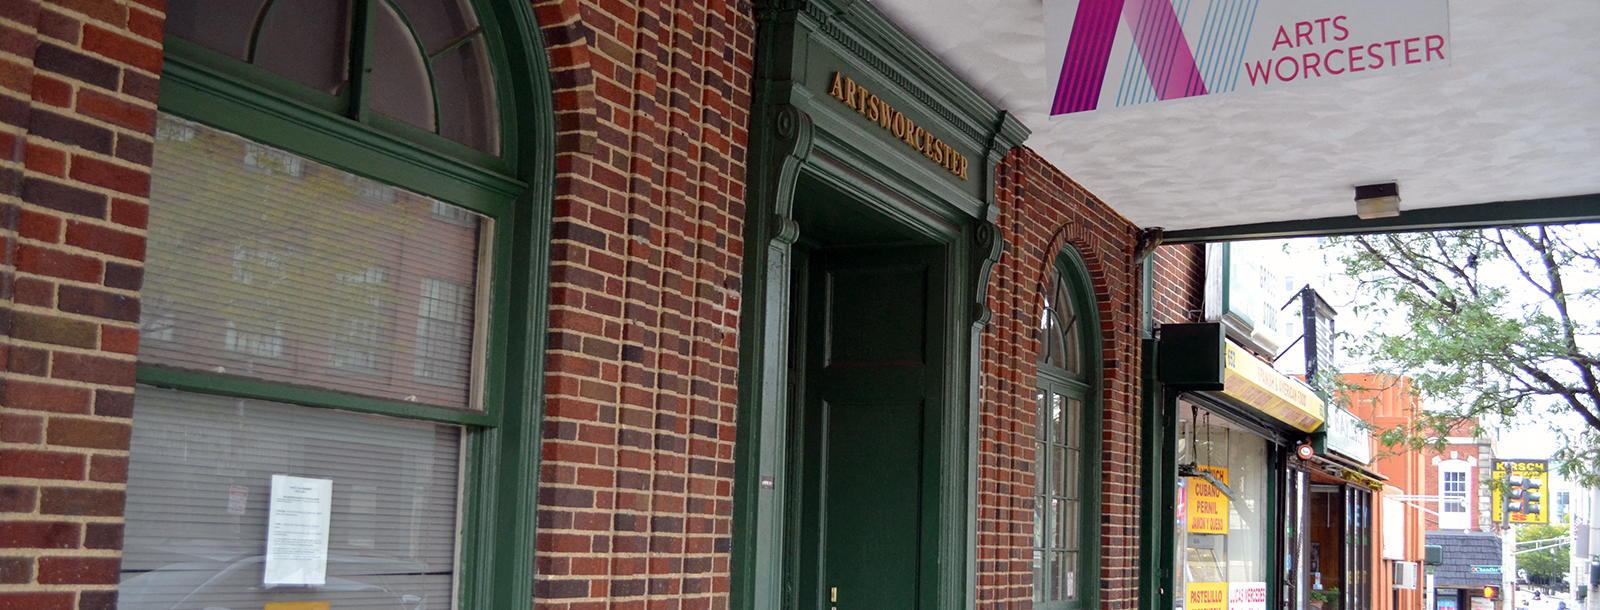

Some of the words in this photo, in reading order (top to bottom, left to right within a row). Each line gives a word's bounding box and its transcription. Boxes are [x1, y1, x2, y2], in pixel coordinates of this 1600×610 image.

[1272, 15, 1349, 51] ARTS
[1245, 34, 1445, 86] WORCESTER
[829, 71, 968, 181] ARTSWORCESTER
[1278, 379, 1298, 401] AMERICAN
[1297, 390, 1307, 408] FOOD
[1496, 462, 1544, 471] KRSCH
[1195, 483, 1220, 498] CUBANO
[1197, 500, 1218, 514] PERNIL
[1210, 517, 1223, 531] QUESO
[1191, 590, 1222, 603] PASTELILLO
[1245, 588, 1266, 603] MERCEDES
